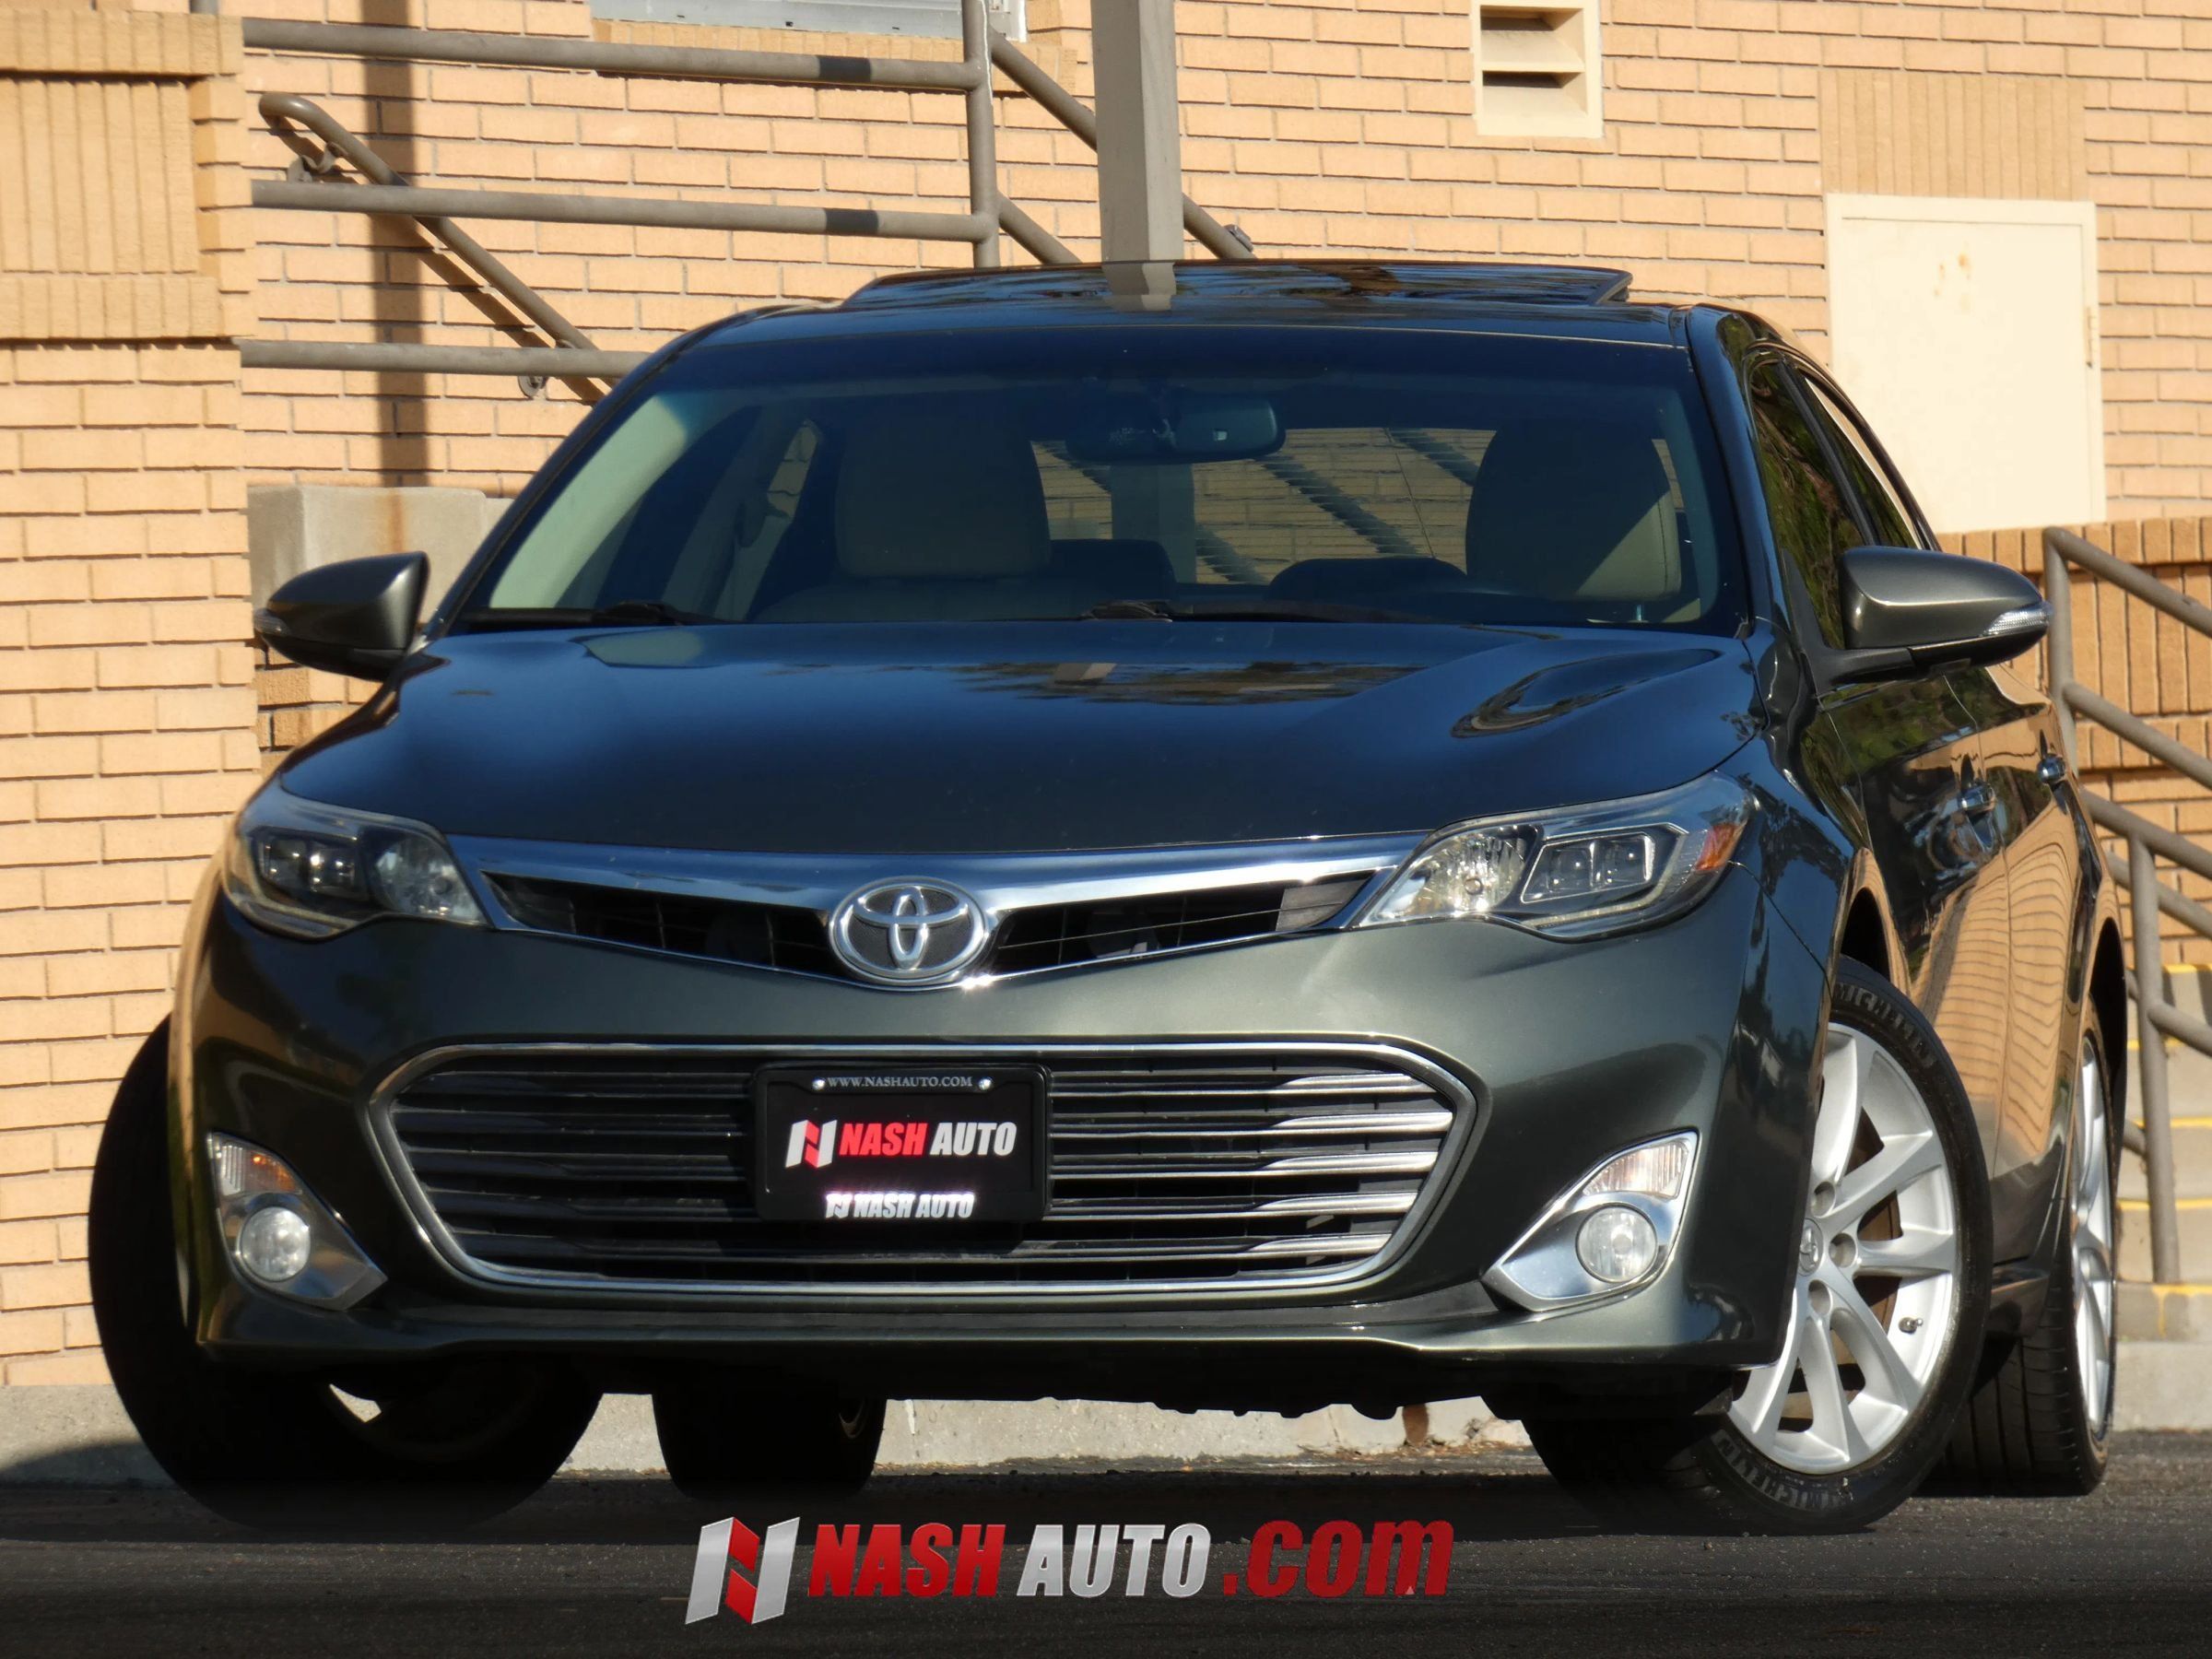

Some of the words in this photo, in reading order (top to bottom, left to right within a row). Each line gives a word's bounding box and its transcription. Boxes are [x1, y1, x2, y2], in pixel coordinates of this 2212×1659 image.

[829, 1076, 973, 1088] WWW.NASHAUTO.COM
[839, 1122, 929, 1157] NASH
[929, 1122, 1018, 1157] AUTO
[853, 1193, 916, 1218] NASH
[915, 1193, 975, 1218] AUTO
